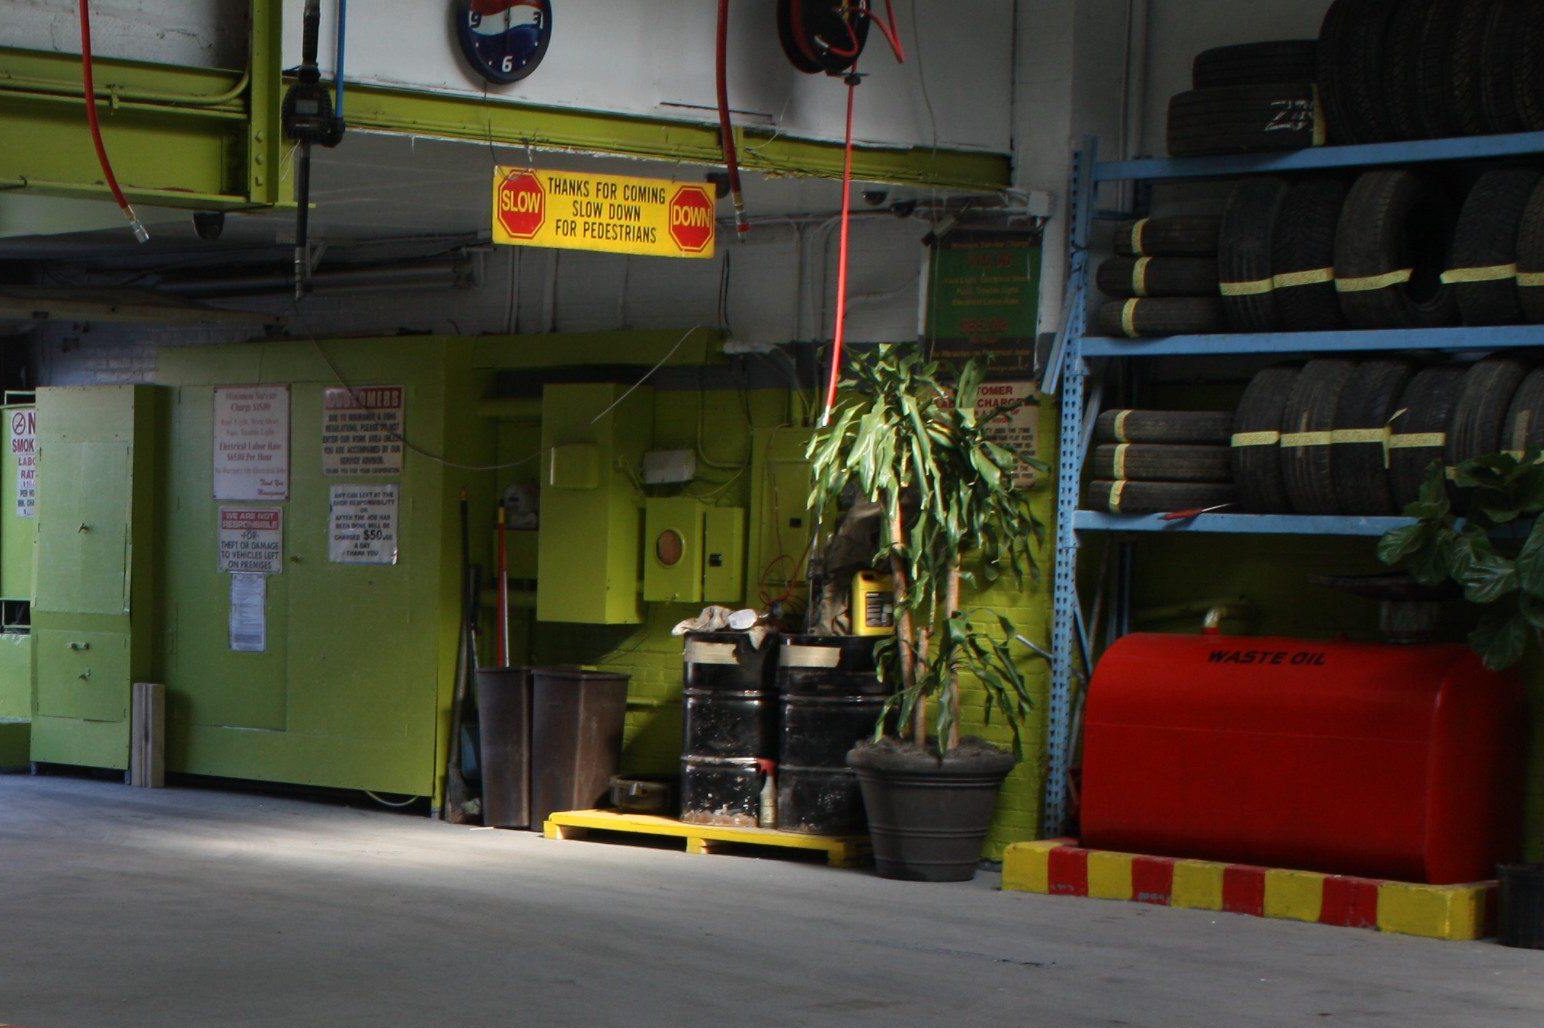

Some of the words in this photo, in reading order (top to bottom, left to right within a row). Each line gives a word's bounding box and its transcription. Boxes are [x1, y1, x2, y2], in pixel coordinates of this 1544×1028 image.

[501, 55, 513, 73] 6
[548, 177, 590, 198] THANKS
[596, 182, 616, 199] FOR
[623, 184, 665, 205] COMING
[501, 189, 541, 214] SLOW
[572, 200, 602, 219] SLOW
[609, 204, 641, 222] DOWN
[672, 204, 712, 229] DOWN
[556, 219, 576, 237] FOR
[583, 221, 656, 243] PEDESTRIANS
[328, 390, 399, 407] CUSTOMERS
[28, 412, 36, 434] N
[12, 439, 35, 453] SMOK
[20, 470, 35, 479] RAT
[226, 512, 238, 520] WE
[239, 512, 255, 520] ARE
[257, 512, 275, 520] NOT
[222, 520, 278, 529] RESPONSIBLE
[221, 541, 238, 550] THEFT
[240, 541, 249, 550] OR
[251, 541, 279, 550] DAMAGE
[221, 551, 230, 559] TO
[232, 551, 263, 560] VEHICLES
[264, 551, 279, 560] LEFT
[228, 561, 239, 569] ON
[241, 561, 272, 570] PREMISES
[1207, 650, 1289, 665] WASTE
[1290, 651, 1327, 666] OIL
